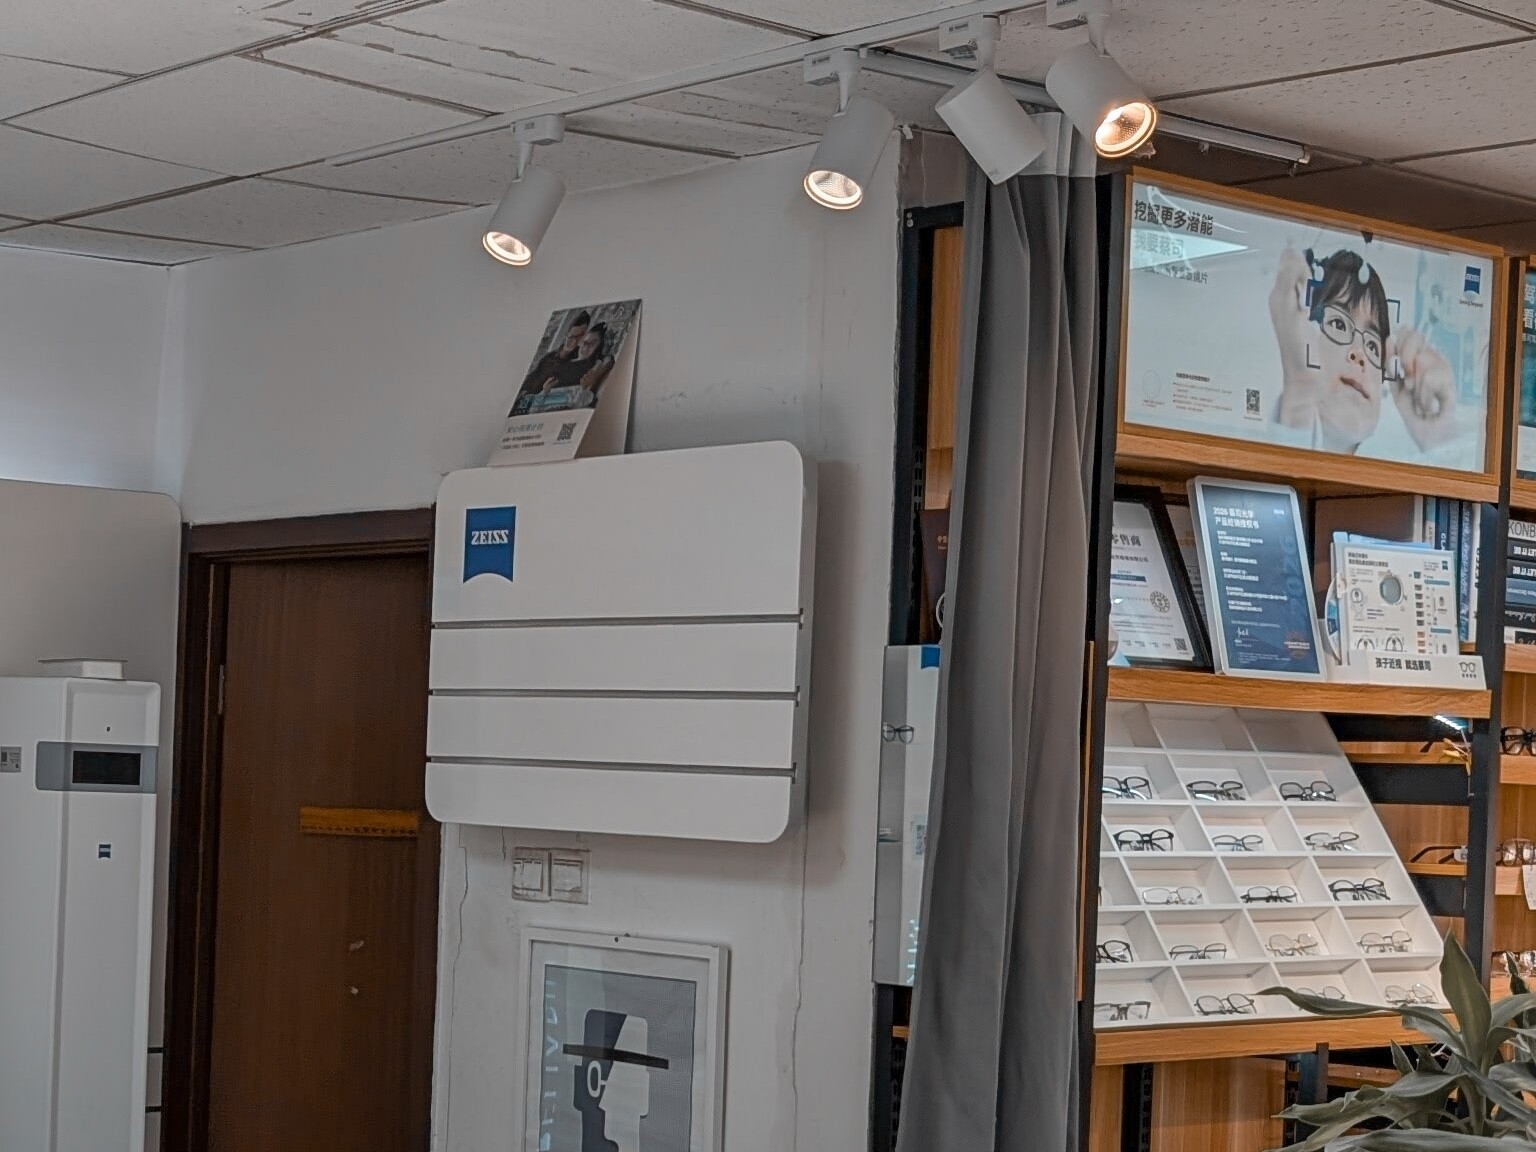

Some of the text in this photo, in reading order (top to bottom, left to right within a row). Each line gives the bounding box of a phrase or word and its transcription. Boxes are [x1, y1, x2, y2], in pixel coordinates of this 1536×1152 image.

[1134, 200, 1214, 236] 挖掘更多潜能
[471, 529, 509, 546] ZEISS
